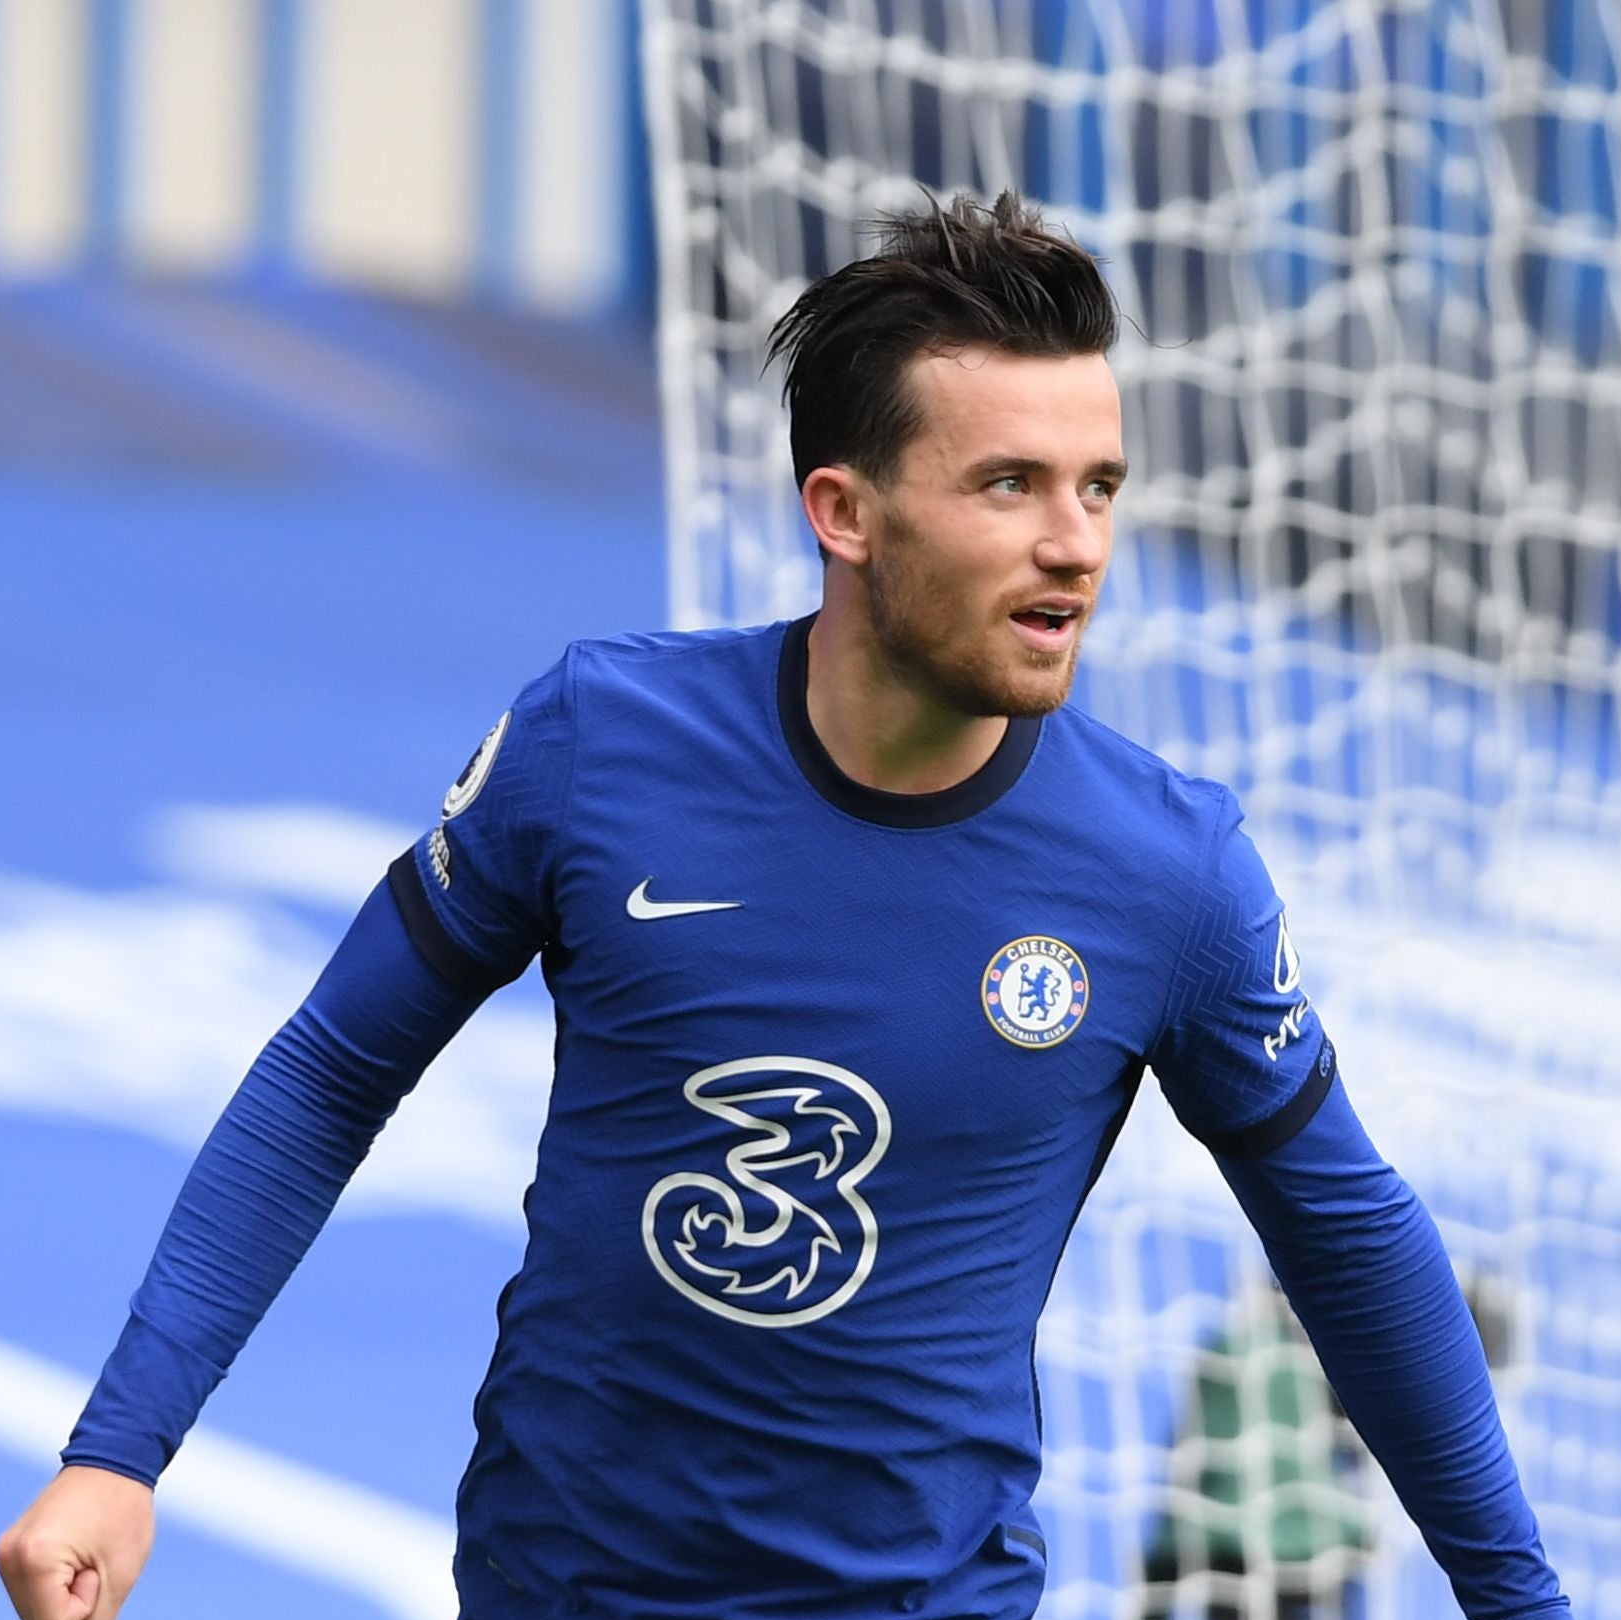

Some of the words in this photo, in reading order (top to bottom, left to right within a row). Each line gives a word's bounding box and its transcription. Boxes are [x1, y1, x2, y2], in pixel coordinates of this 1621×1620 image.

[1006, 941, 1075, 969] CHELSEA
[997, 1016, 1040, 1042] FOOTBALL
[1043, 1024, 1067, 1041] CLUB
